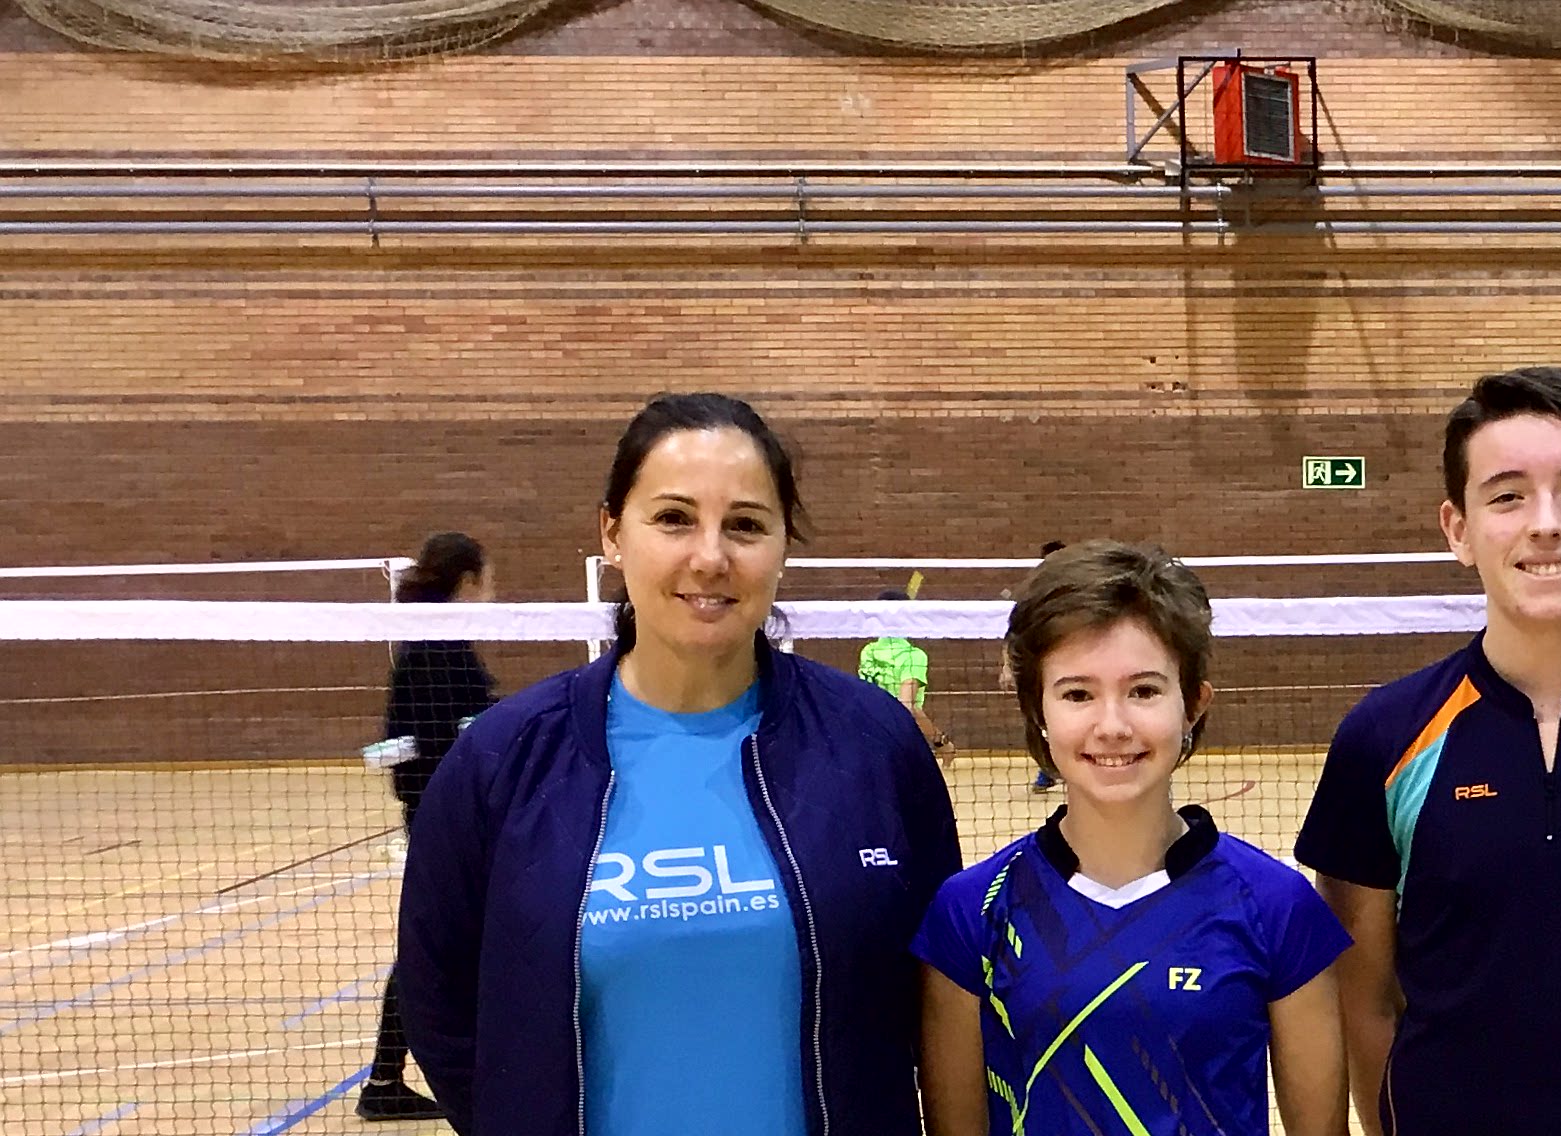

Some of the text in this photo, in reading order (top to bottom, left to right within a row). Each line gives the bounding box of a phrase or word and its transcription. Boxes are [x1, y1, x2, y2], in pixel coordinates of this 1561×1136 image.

[1455, 783, 1498, 800] RSL
[859, 848, 898, 867] RSL
[591, 845, 775, 902] RSL
[1169, 967, 1202, 991] FZ
